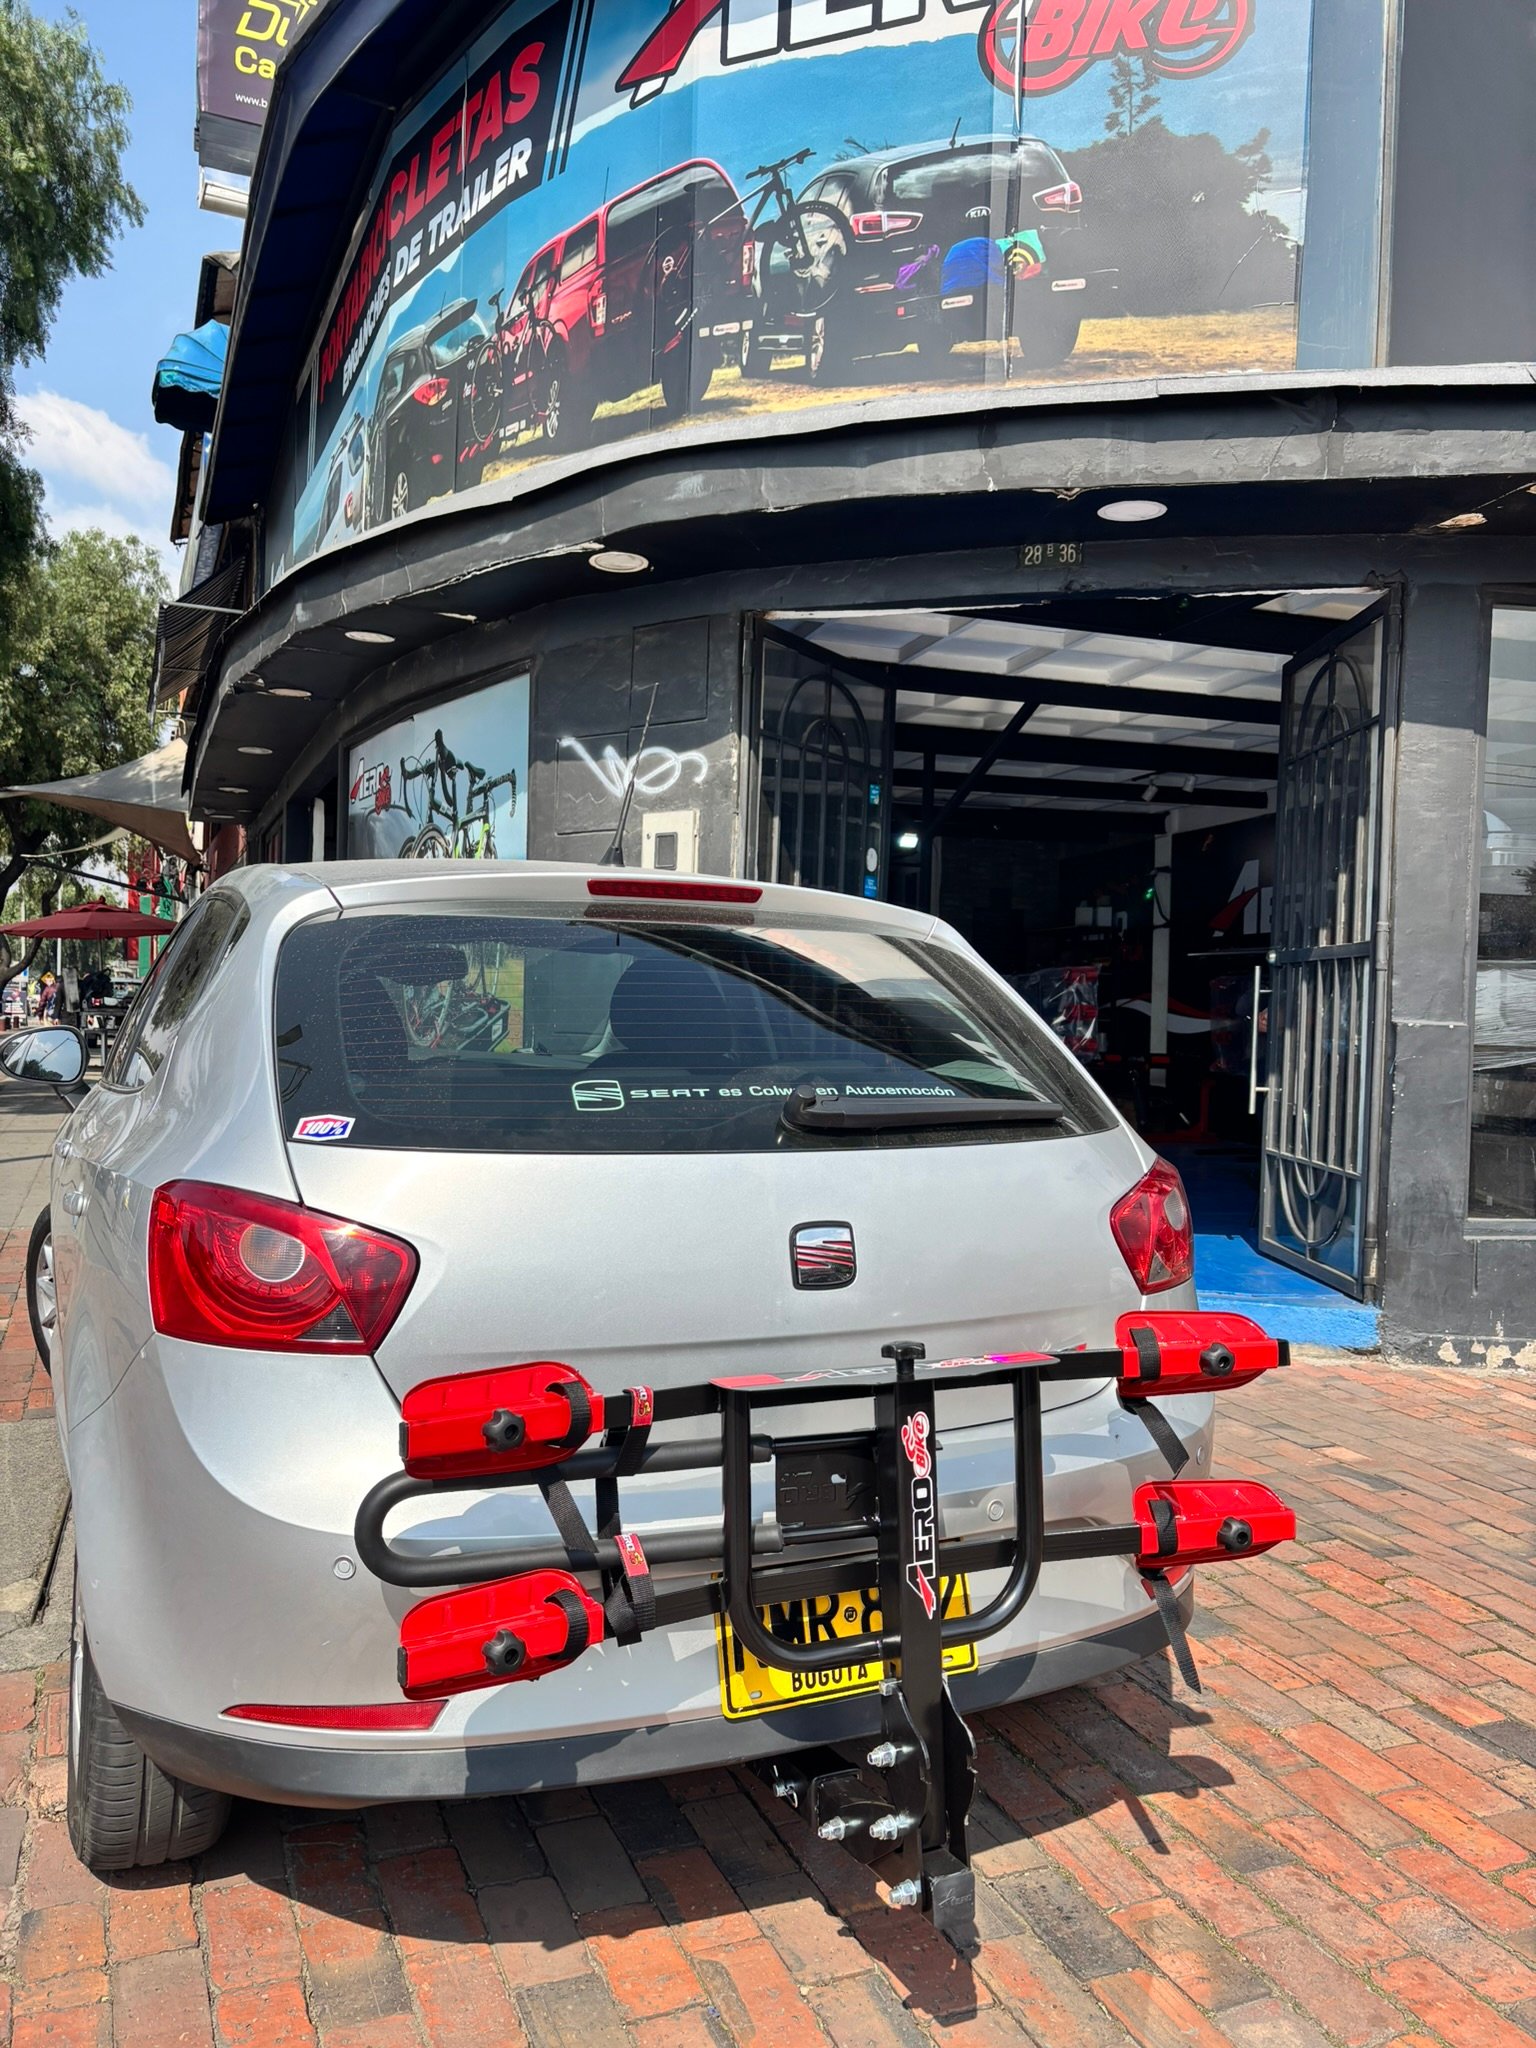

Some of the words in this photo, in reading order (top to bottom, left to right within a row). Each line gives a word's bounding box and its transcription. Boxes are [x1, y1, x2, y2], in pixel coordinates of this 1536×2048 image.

[392, 228, 425, 289] DE
[427, 137, 533, 257] TRAILER
[1023, 544, 1043, 566] 28
[1059, 543, 1077, 563] 36
[629, 1088, 710, 1099] SEAT
[718, 1087, 743, 1097] es
[748, 1085, 838, 1098] Colwen
[845, 1085, 956, 1098] Autoemoción
[302, 1120, 346, 1135] 100%
[906, 1477, 936, 1620] AERO
